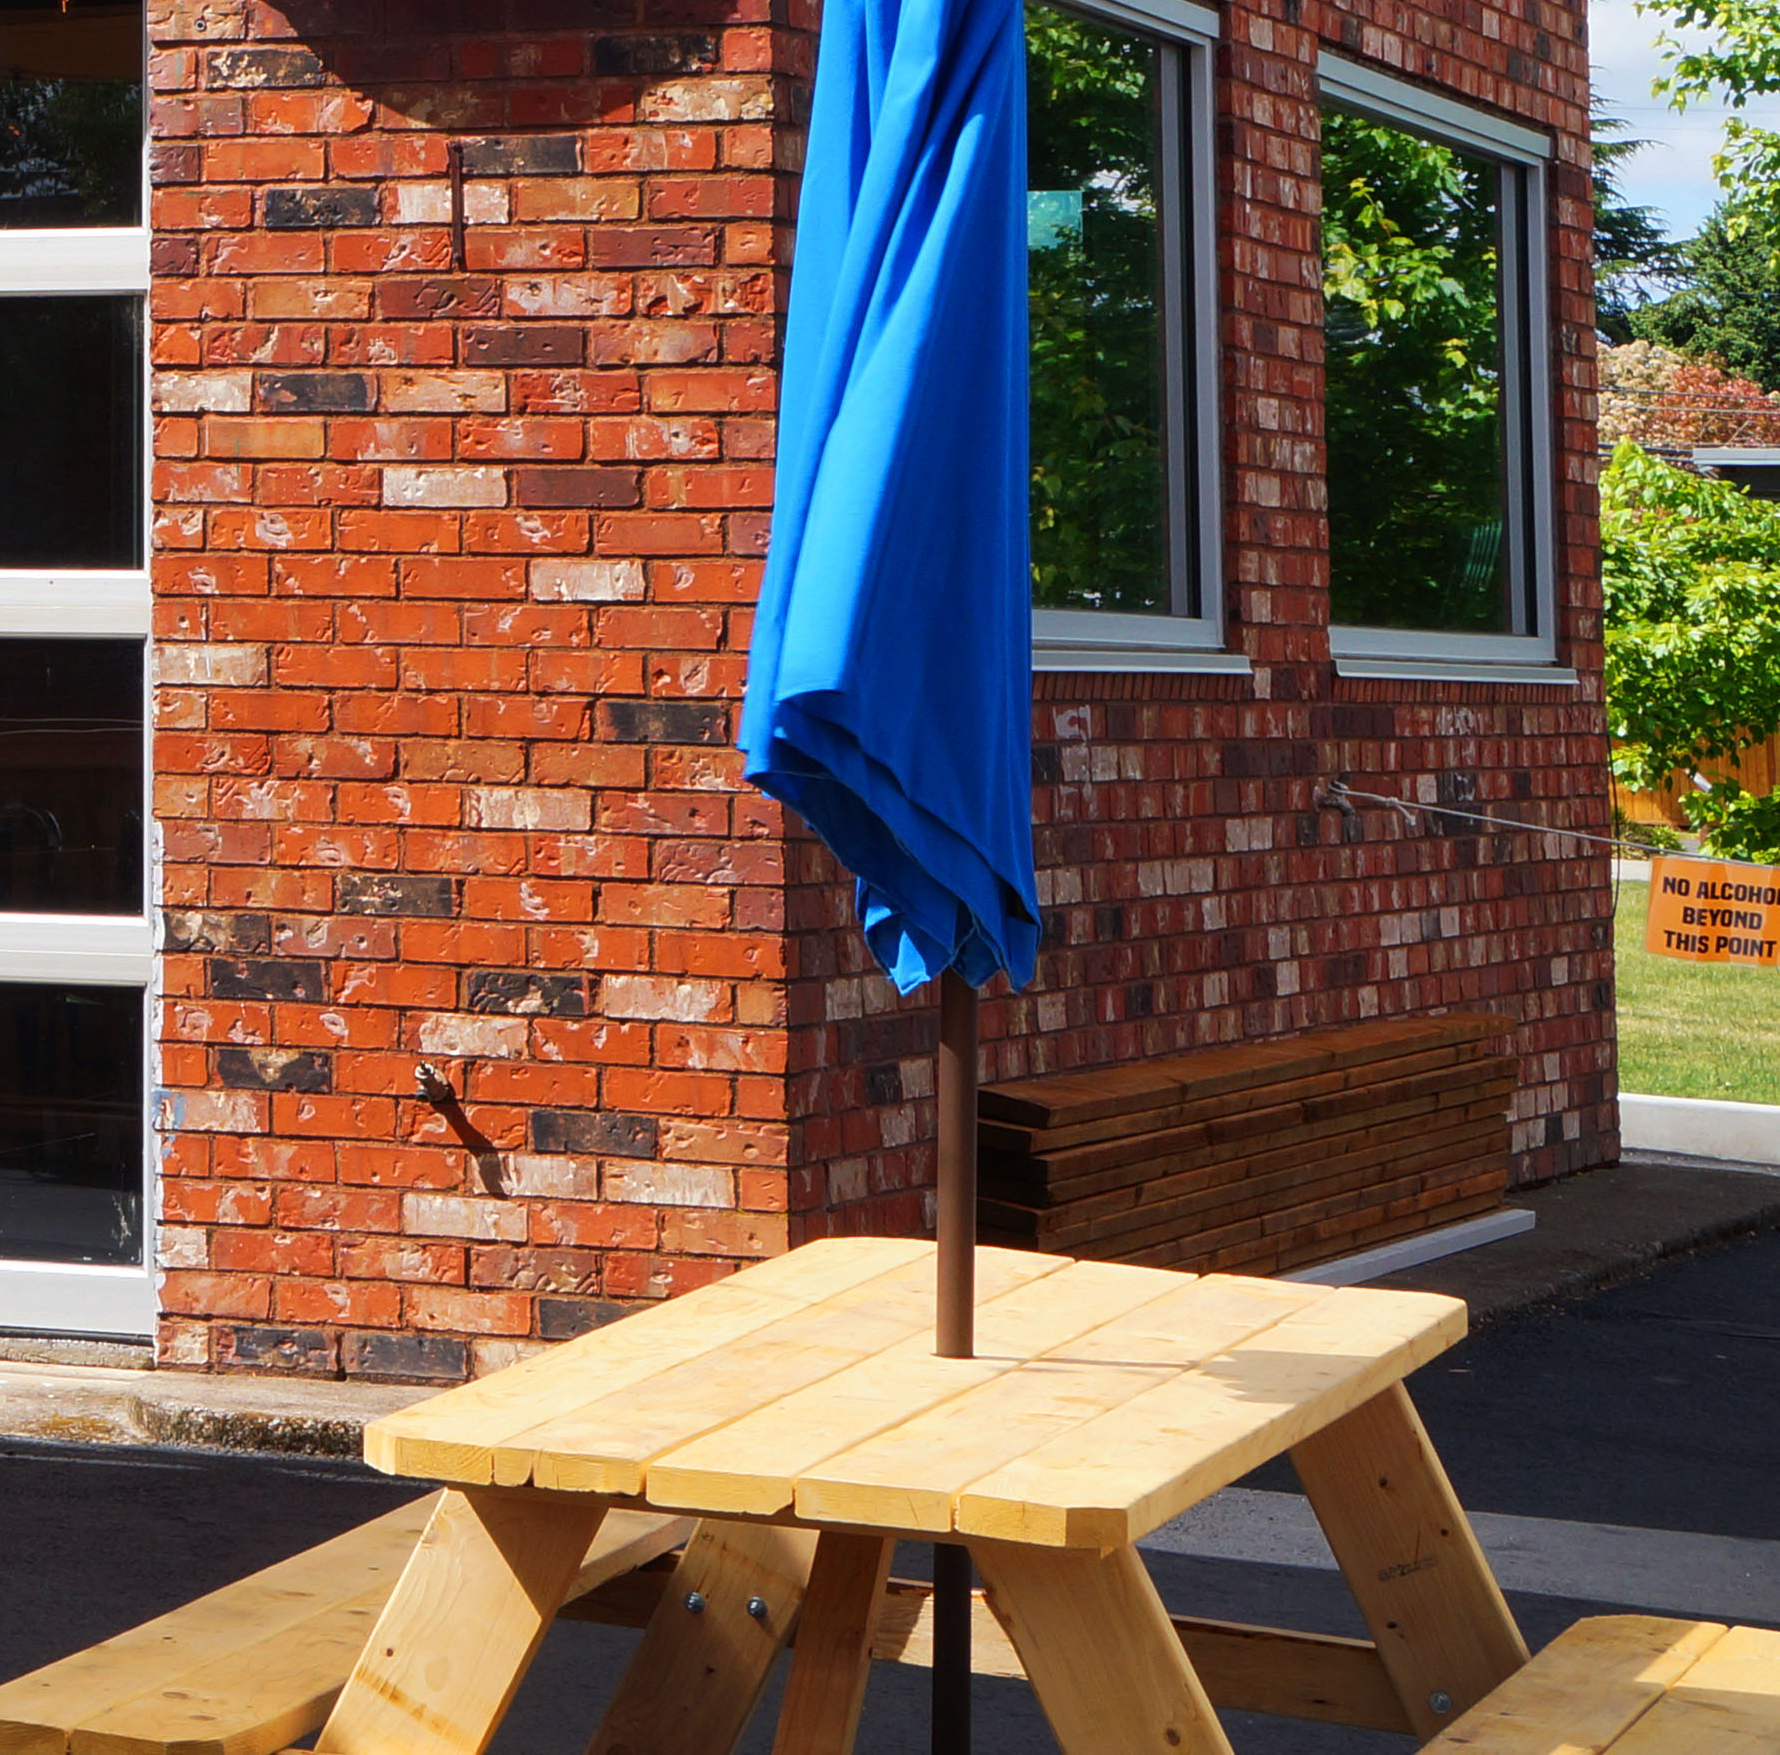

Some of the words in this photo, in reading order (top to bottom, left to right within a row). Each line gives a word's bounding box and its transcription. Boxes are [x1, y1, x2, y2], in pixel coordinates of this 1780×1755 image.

[1662, 876, 1691, 897] NO
[1682, 906, 1763, 931] BEYOND
[1663, 930, 1710, 954] THIS
[1715, 936, 1777, 958] POINT
